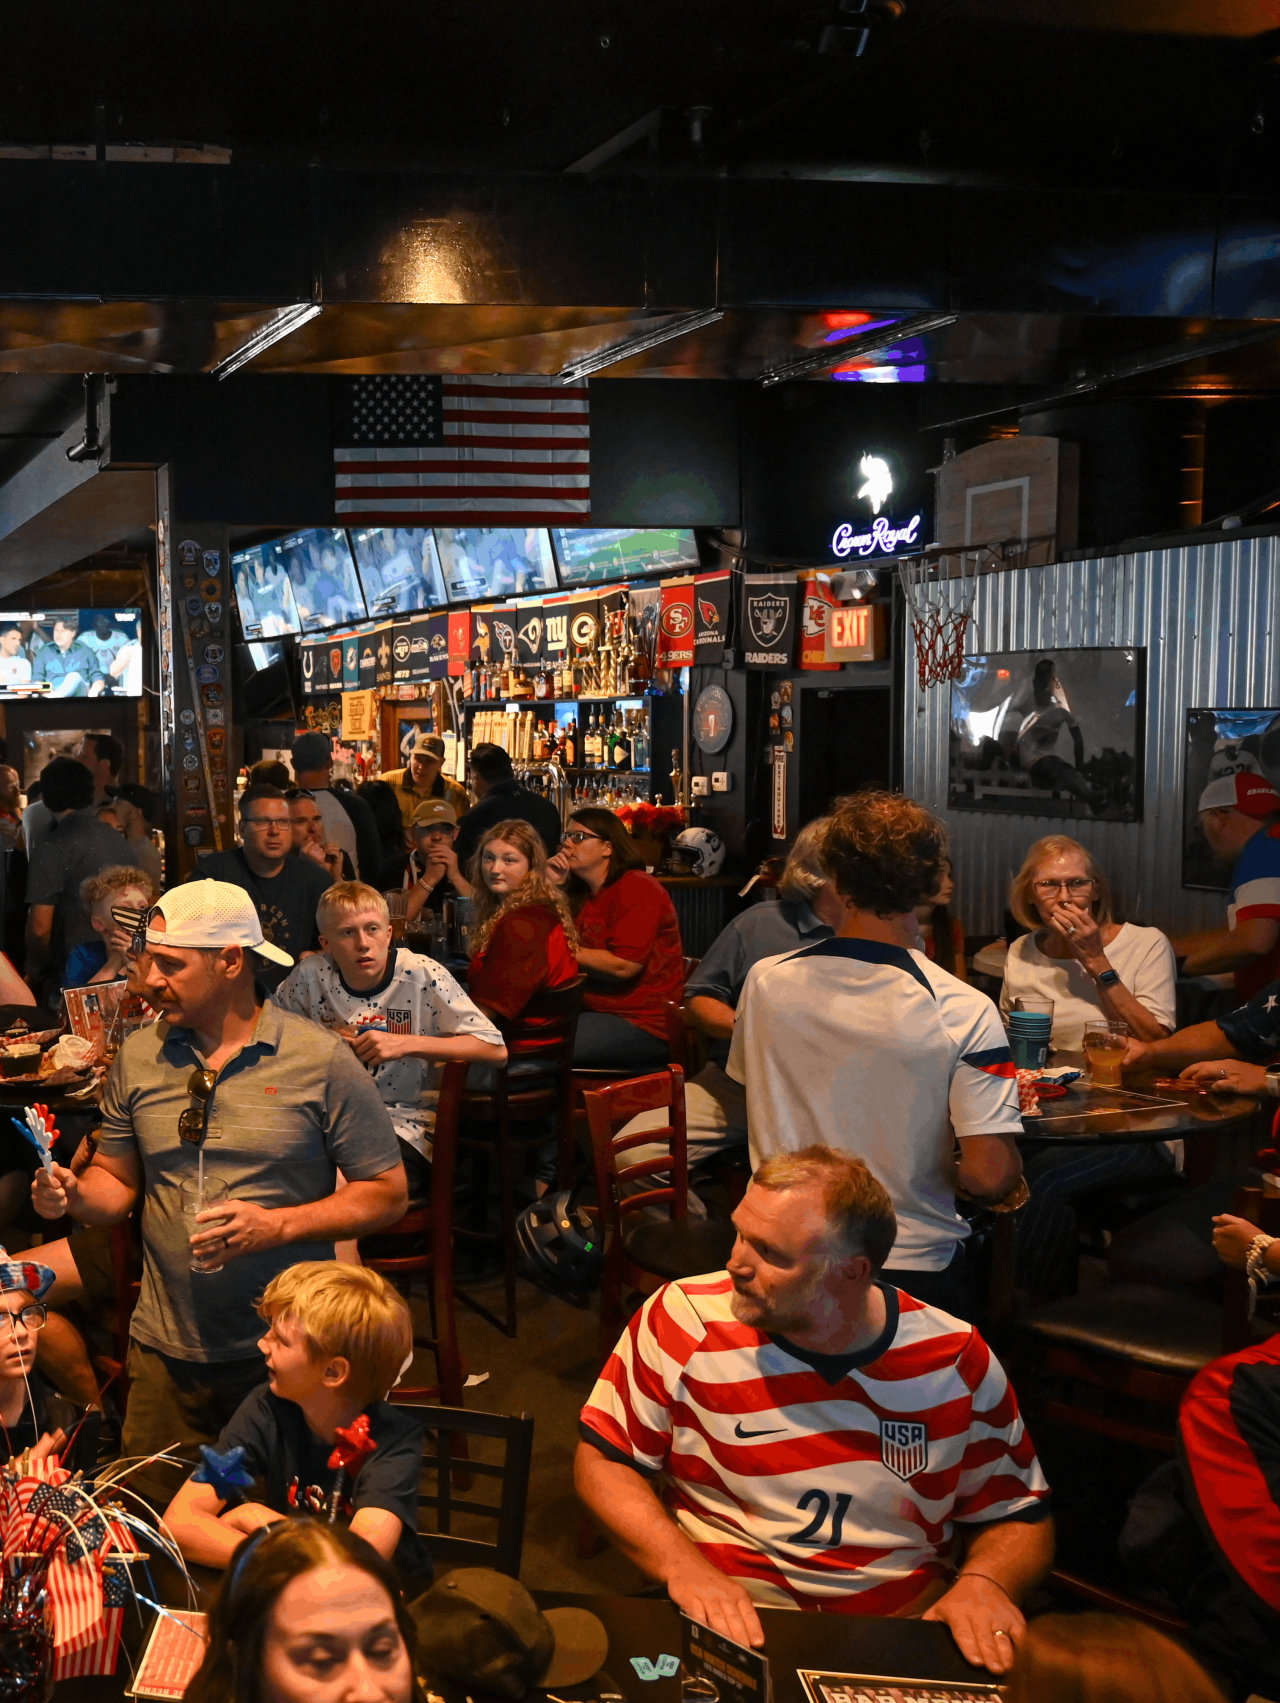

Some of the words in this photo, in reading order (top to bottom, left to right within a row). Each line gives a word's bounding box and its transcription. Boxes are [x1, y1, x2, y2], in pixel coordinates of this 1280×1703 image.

[832, 523, 872, 557] Crown
[859, 517, 920, 555] Royal
[831, 608, 869, 648] EXIT
[693, 634, 726, 646] CARDINALS
[429, 653, 449, 663] RAVENS
[744, 652, 788, 664] RAIDERS
[802, 650, 826, 663] CHIE
[394, 670, 410, 678] JETS
[389, 1010, 409, 1024] USA
[884, 1423, 923, 1447] USA
[787, 1488, 853, 1546] 21
